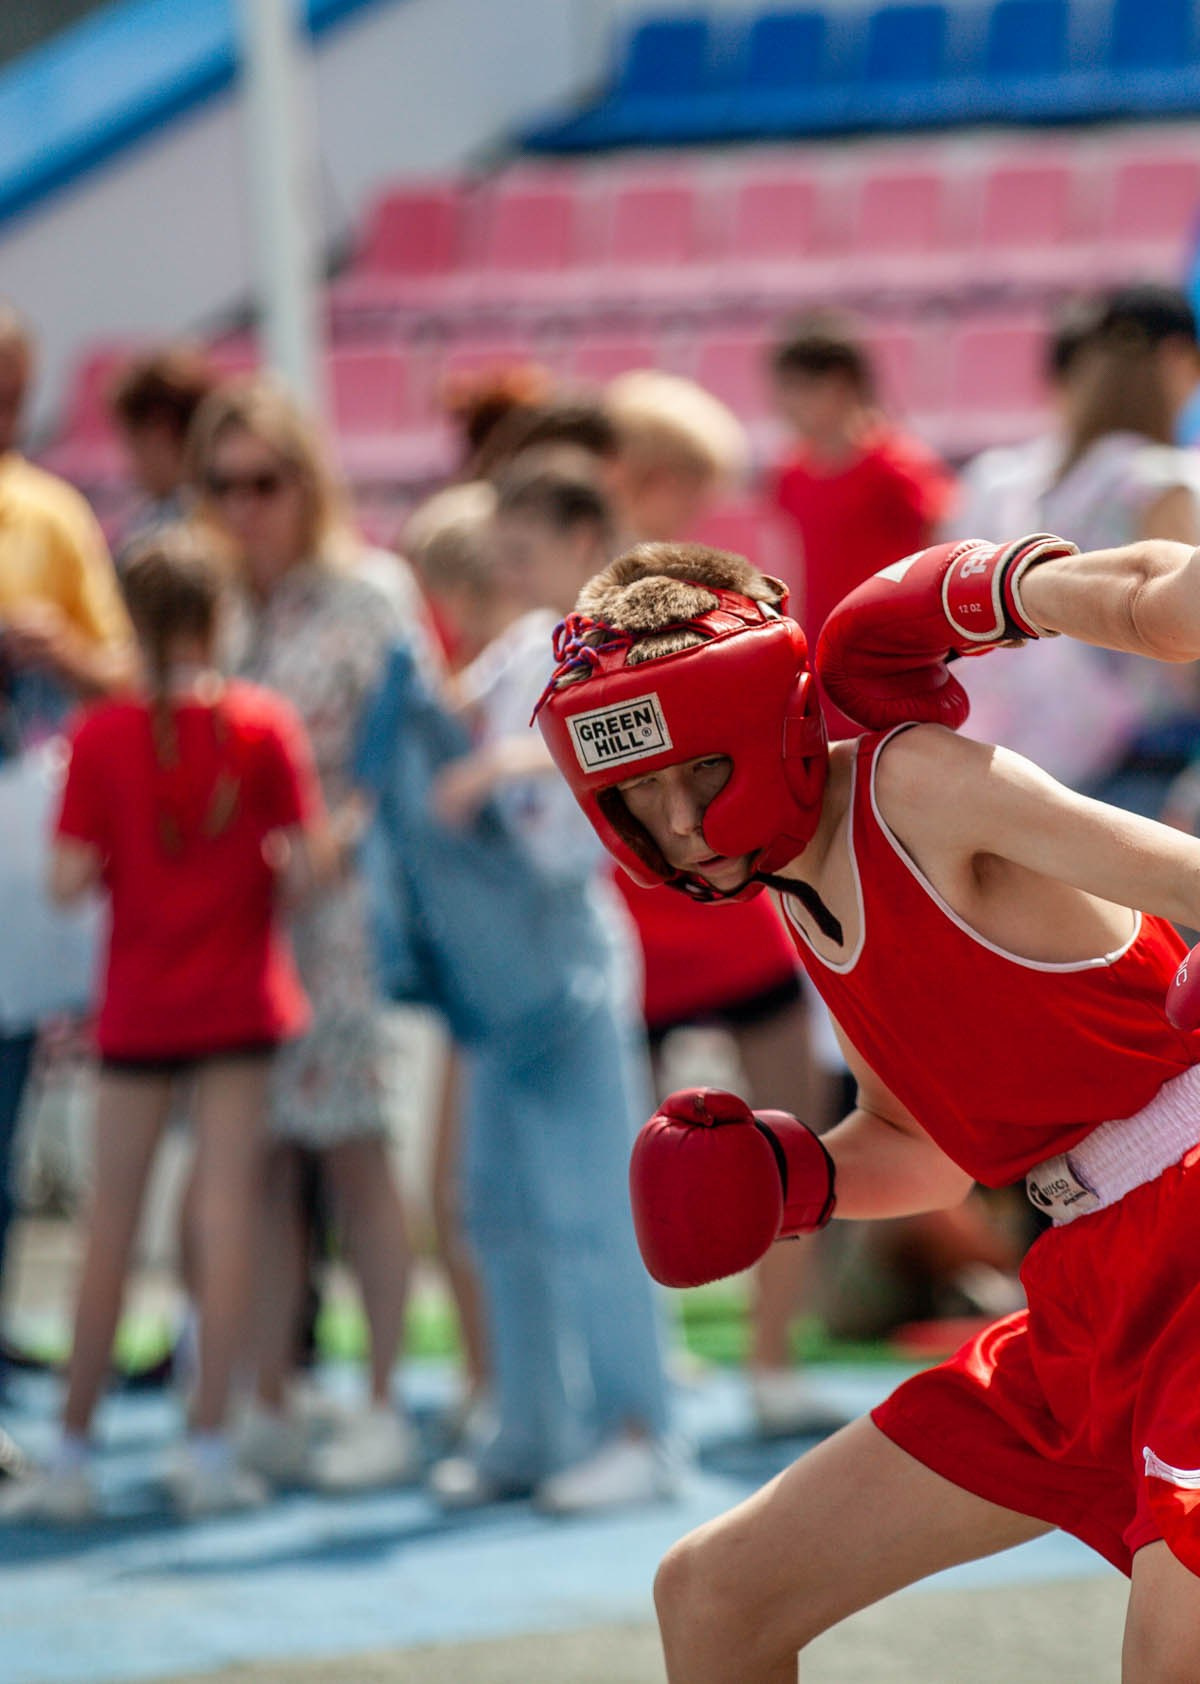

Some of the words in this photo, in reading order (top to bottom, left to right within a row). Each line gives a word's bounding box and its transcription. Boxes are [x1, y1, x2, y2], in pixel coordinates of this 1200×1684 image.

[958, 604, 969, 614] 12
[580, 708, 652, 741] GREEN
[594, 732, 644, 757] HILL
